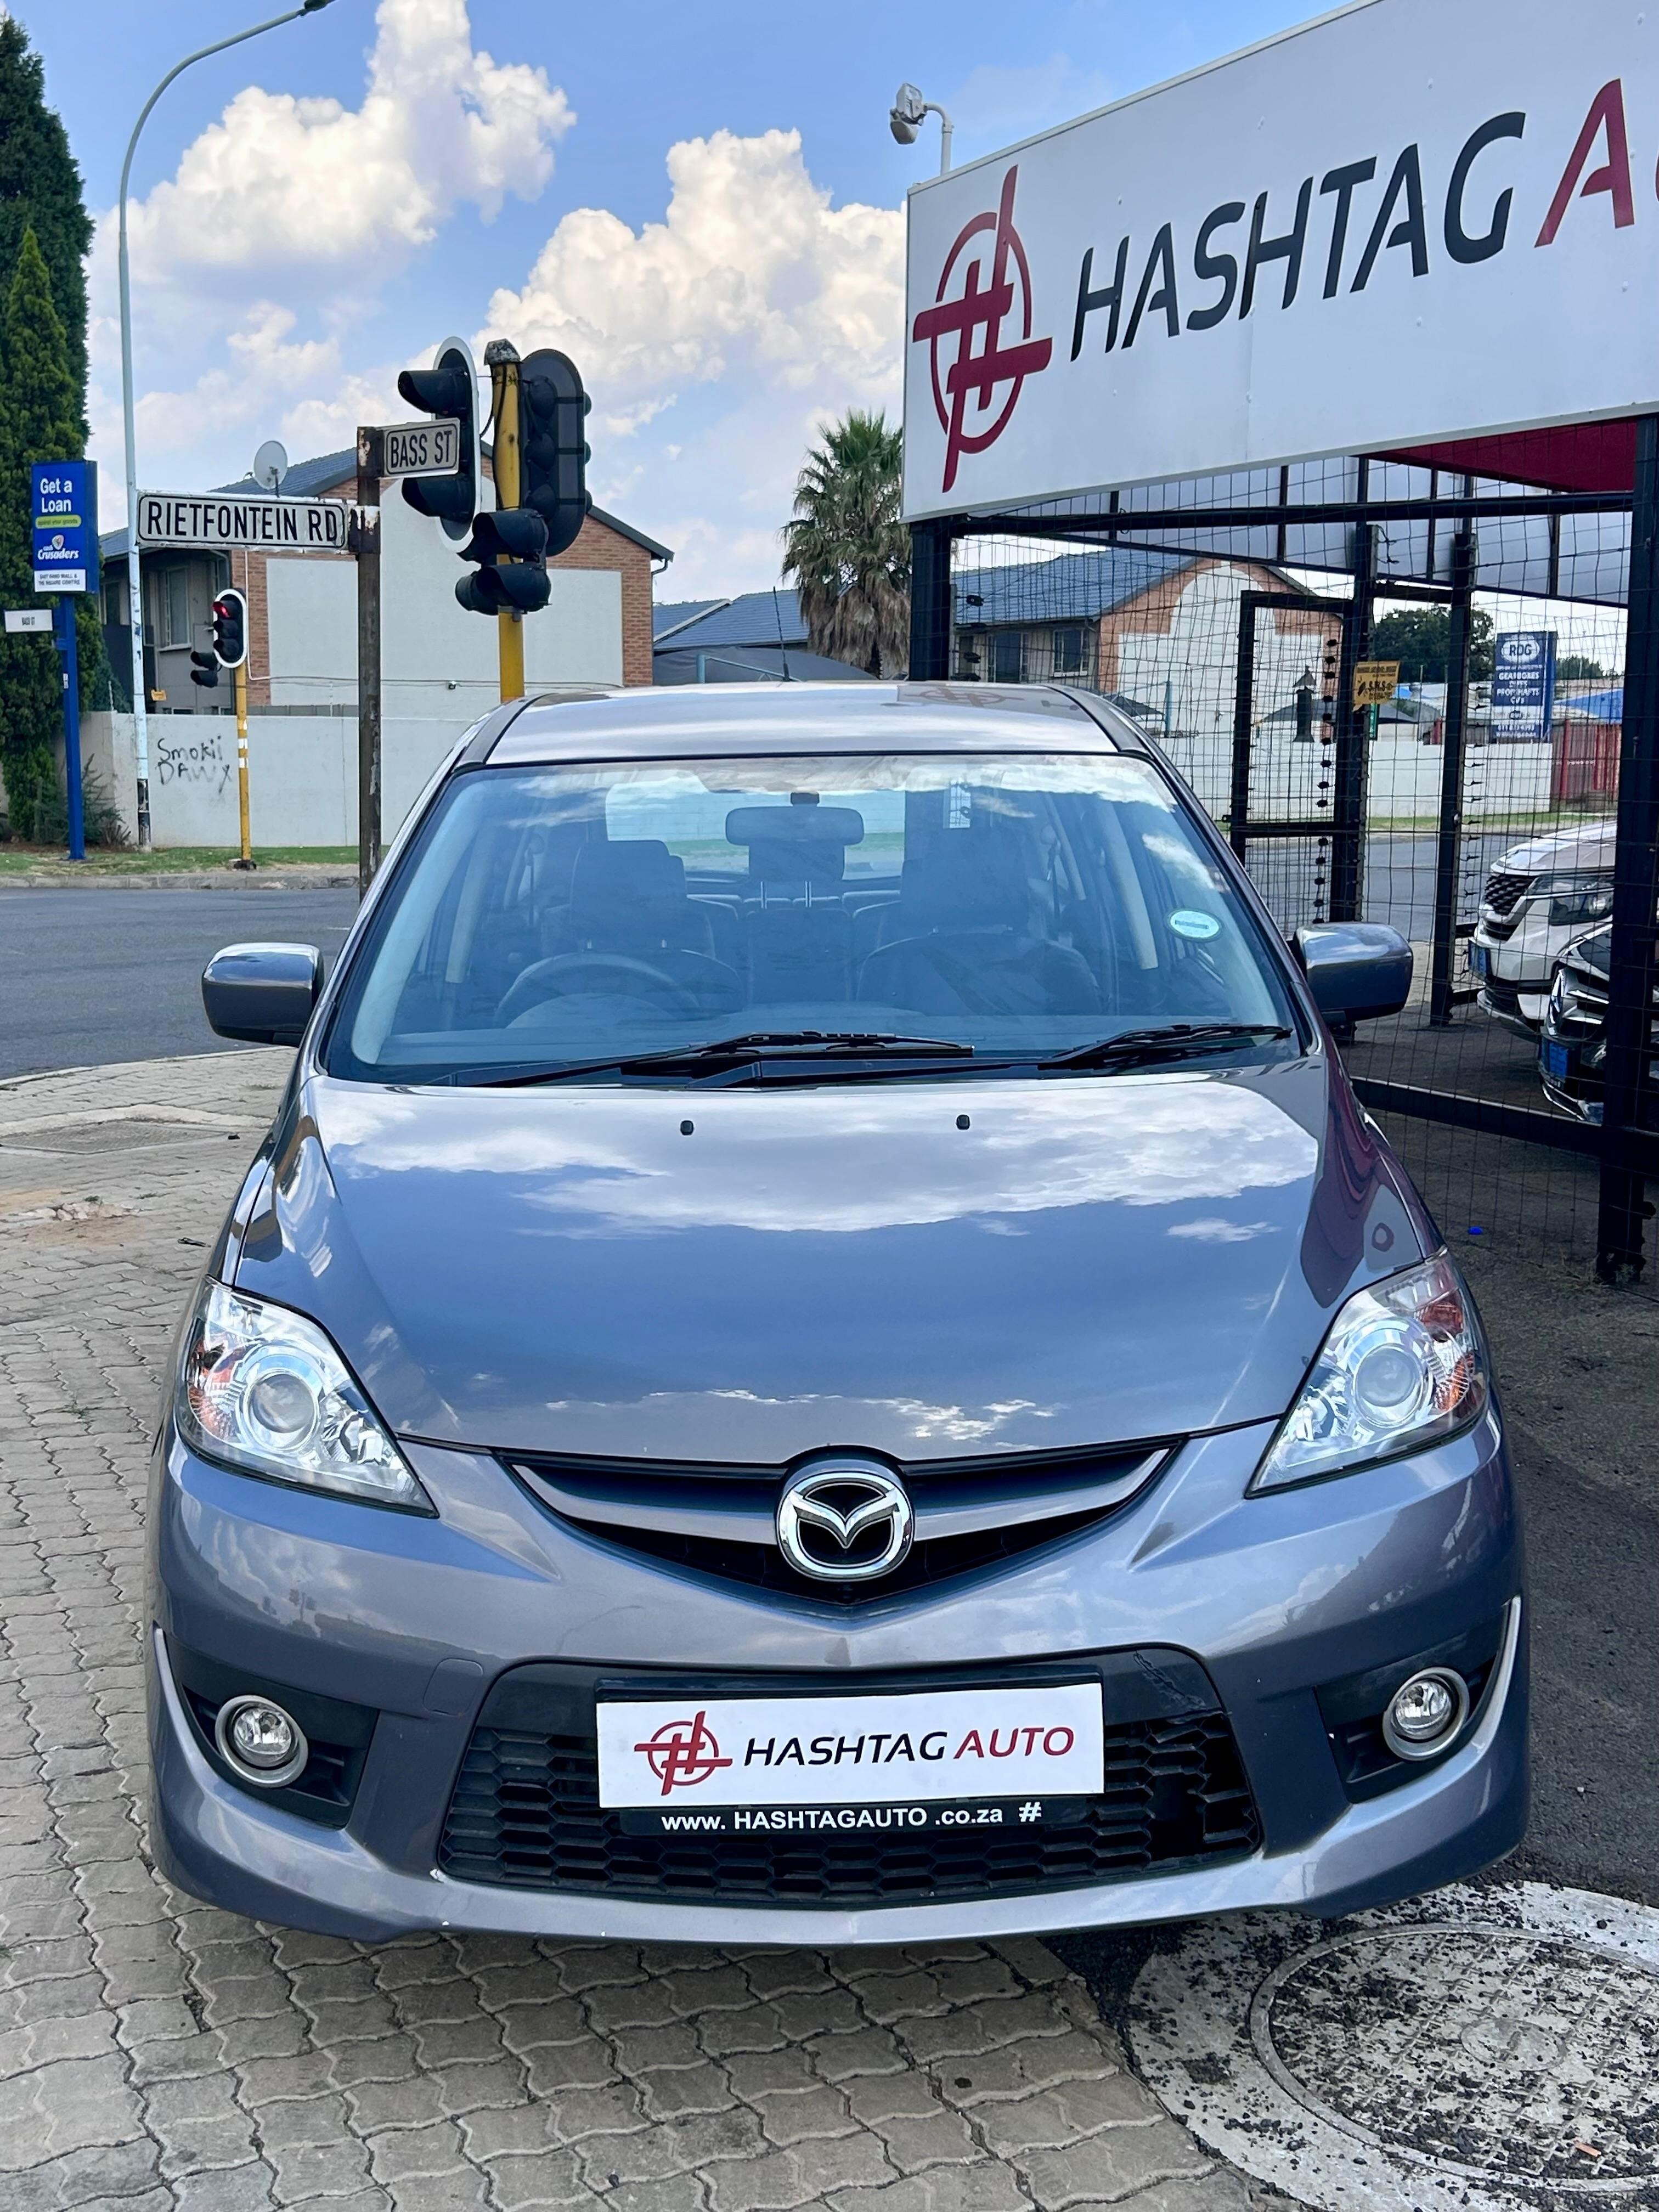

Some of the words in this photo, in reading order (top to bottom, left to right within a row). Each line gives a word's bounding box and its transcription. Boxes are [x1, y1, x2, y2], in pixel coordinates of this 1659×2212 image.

[1070, 110, 1526, 362] HASHTAG
[1534, 77, 1659, 248] A
[391, 433, 428, 468] BASS
[435, 430, 453, 463] ST
[40, 478, 61, 494] Get
[64, 479, 72, 493] a
[41, 498, 72, 513] Loan
[148, 501, 298, 541] RIETFONTEIN
[308, 509, 338, 542] RD
[37, 548, 80, 560] Crusaders
[743, 1731, 948, 1767] HASHTAG
[952, 1726, 1075, 1759] AUTO
[661, 1814, 726, 1831] www.
[734, 1807, 927, 1830] HASHTAGAUTO
[934, 1806, 1003, 1825] .co.za
